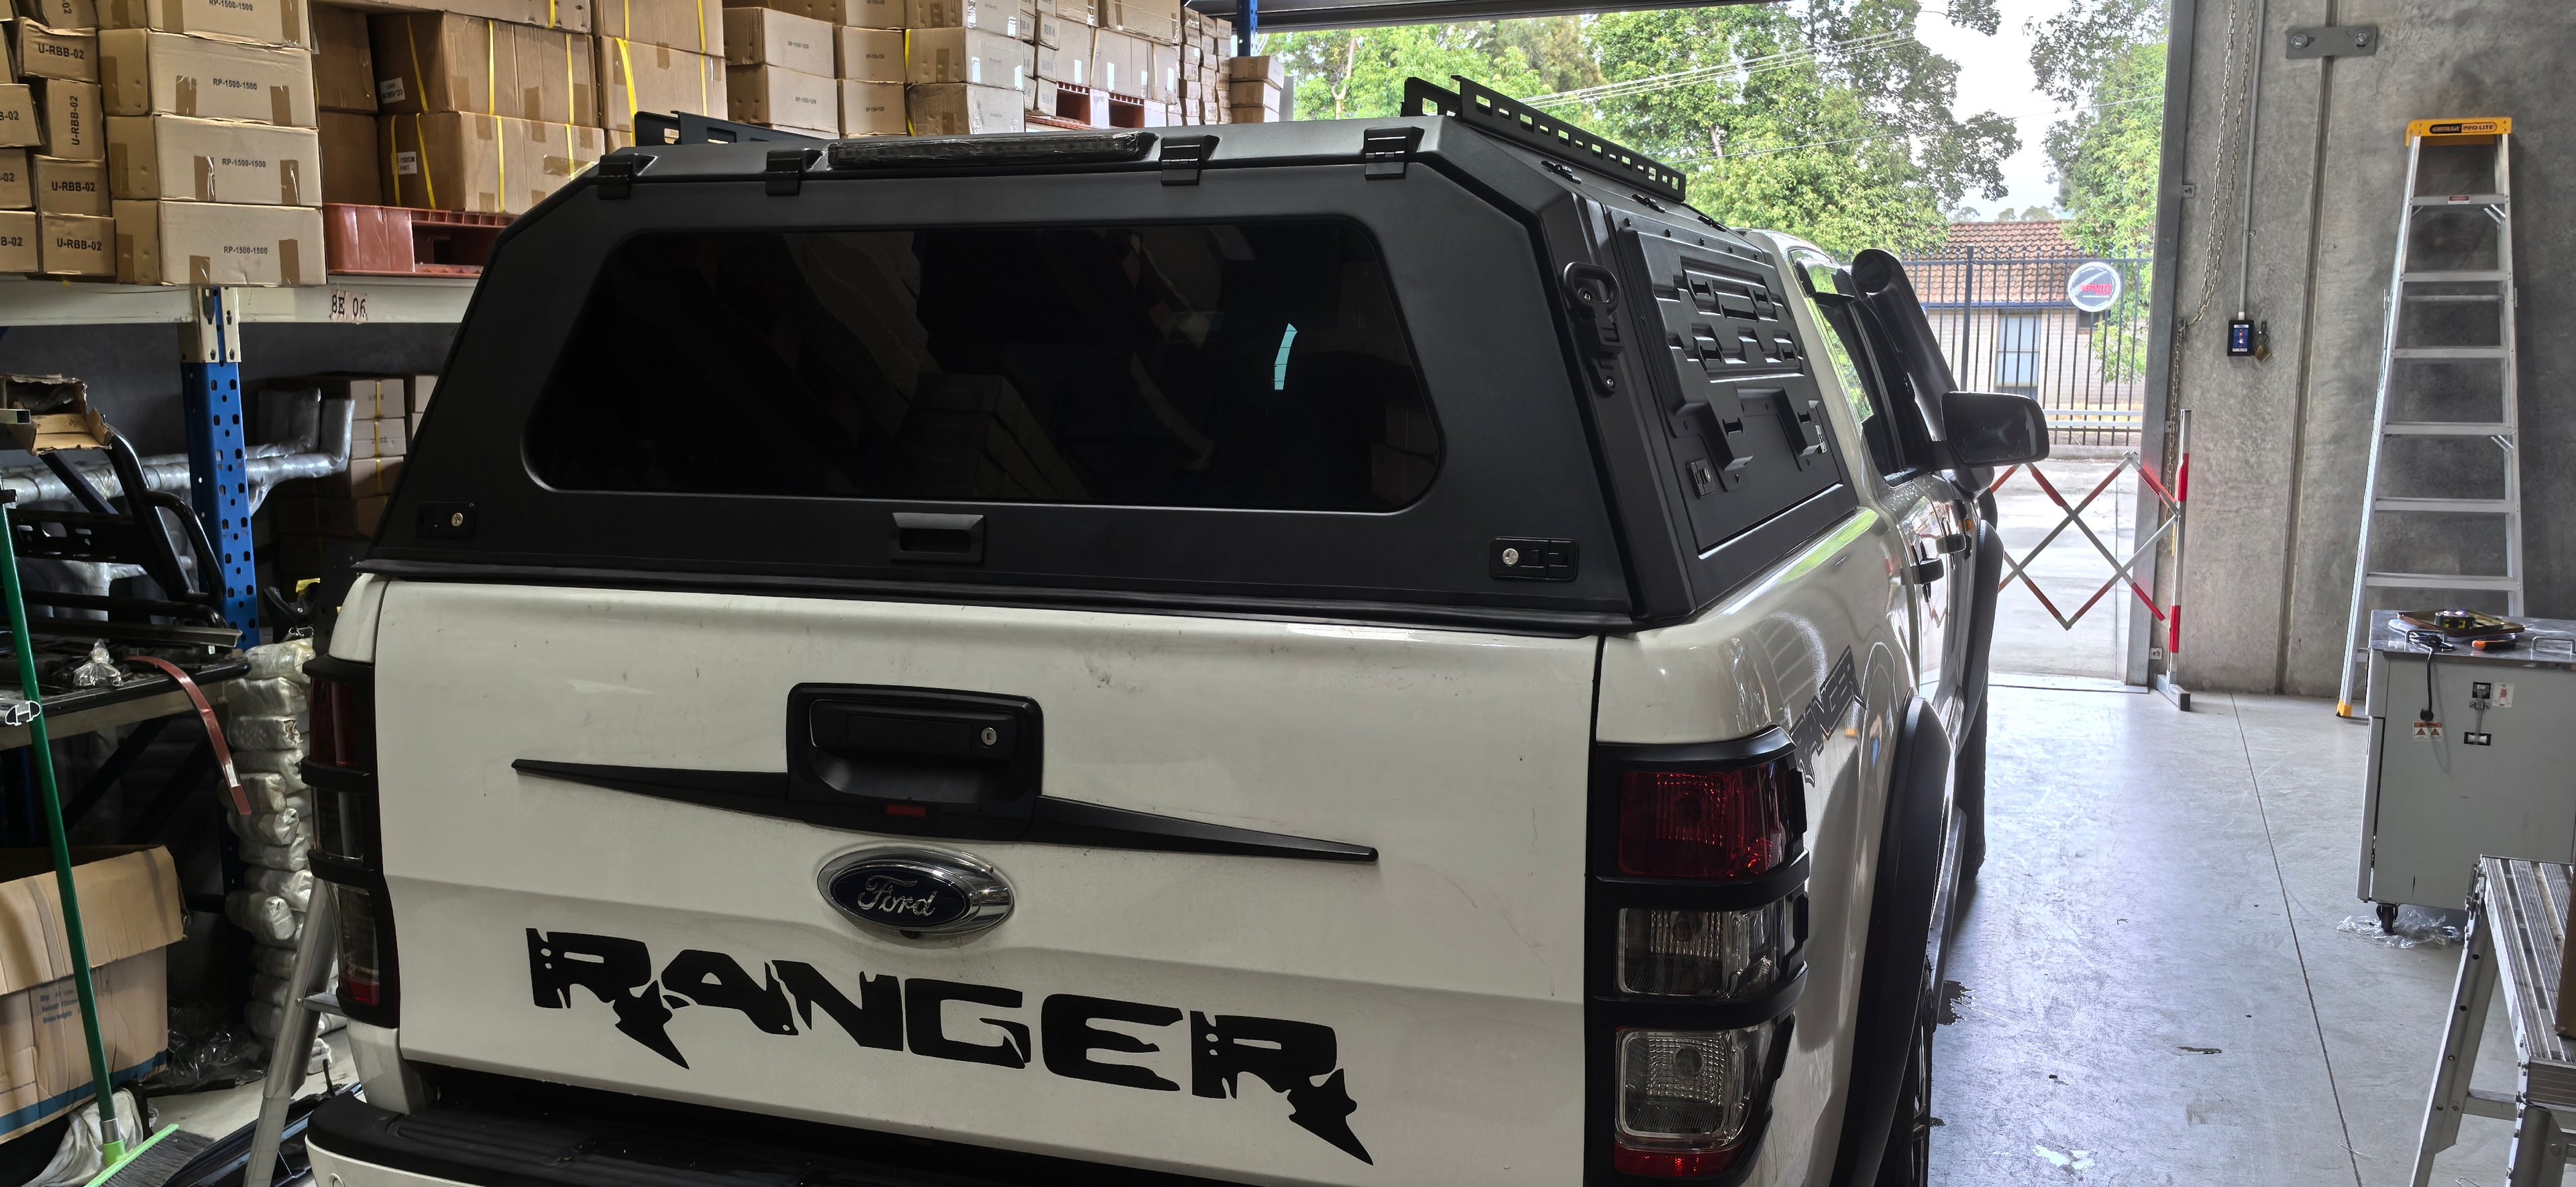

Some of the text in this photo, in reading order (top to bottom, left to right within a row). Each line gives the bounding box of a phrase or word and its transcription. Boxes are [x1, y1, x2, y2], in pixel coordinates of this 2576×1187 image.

[38, 43, 85, 60] U-RBB-02
[213, 78, 258, 90] RP-1500-1500
[70, 95, 80, 146] U-RBB-02
[222, 158, 266, 168] RP-1500-1500
[52, 181, 96, 192] U-RBB-02
[57, 237, 102, 251] U-RBB-02
[223, 246, 268, 254] RP-1500-1500
[857, 874, 938, 917] Ford
[526, 927, 1375, 1166] RANGER
